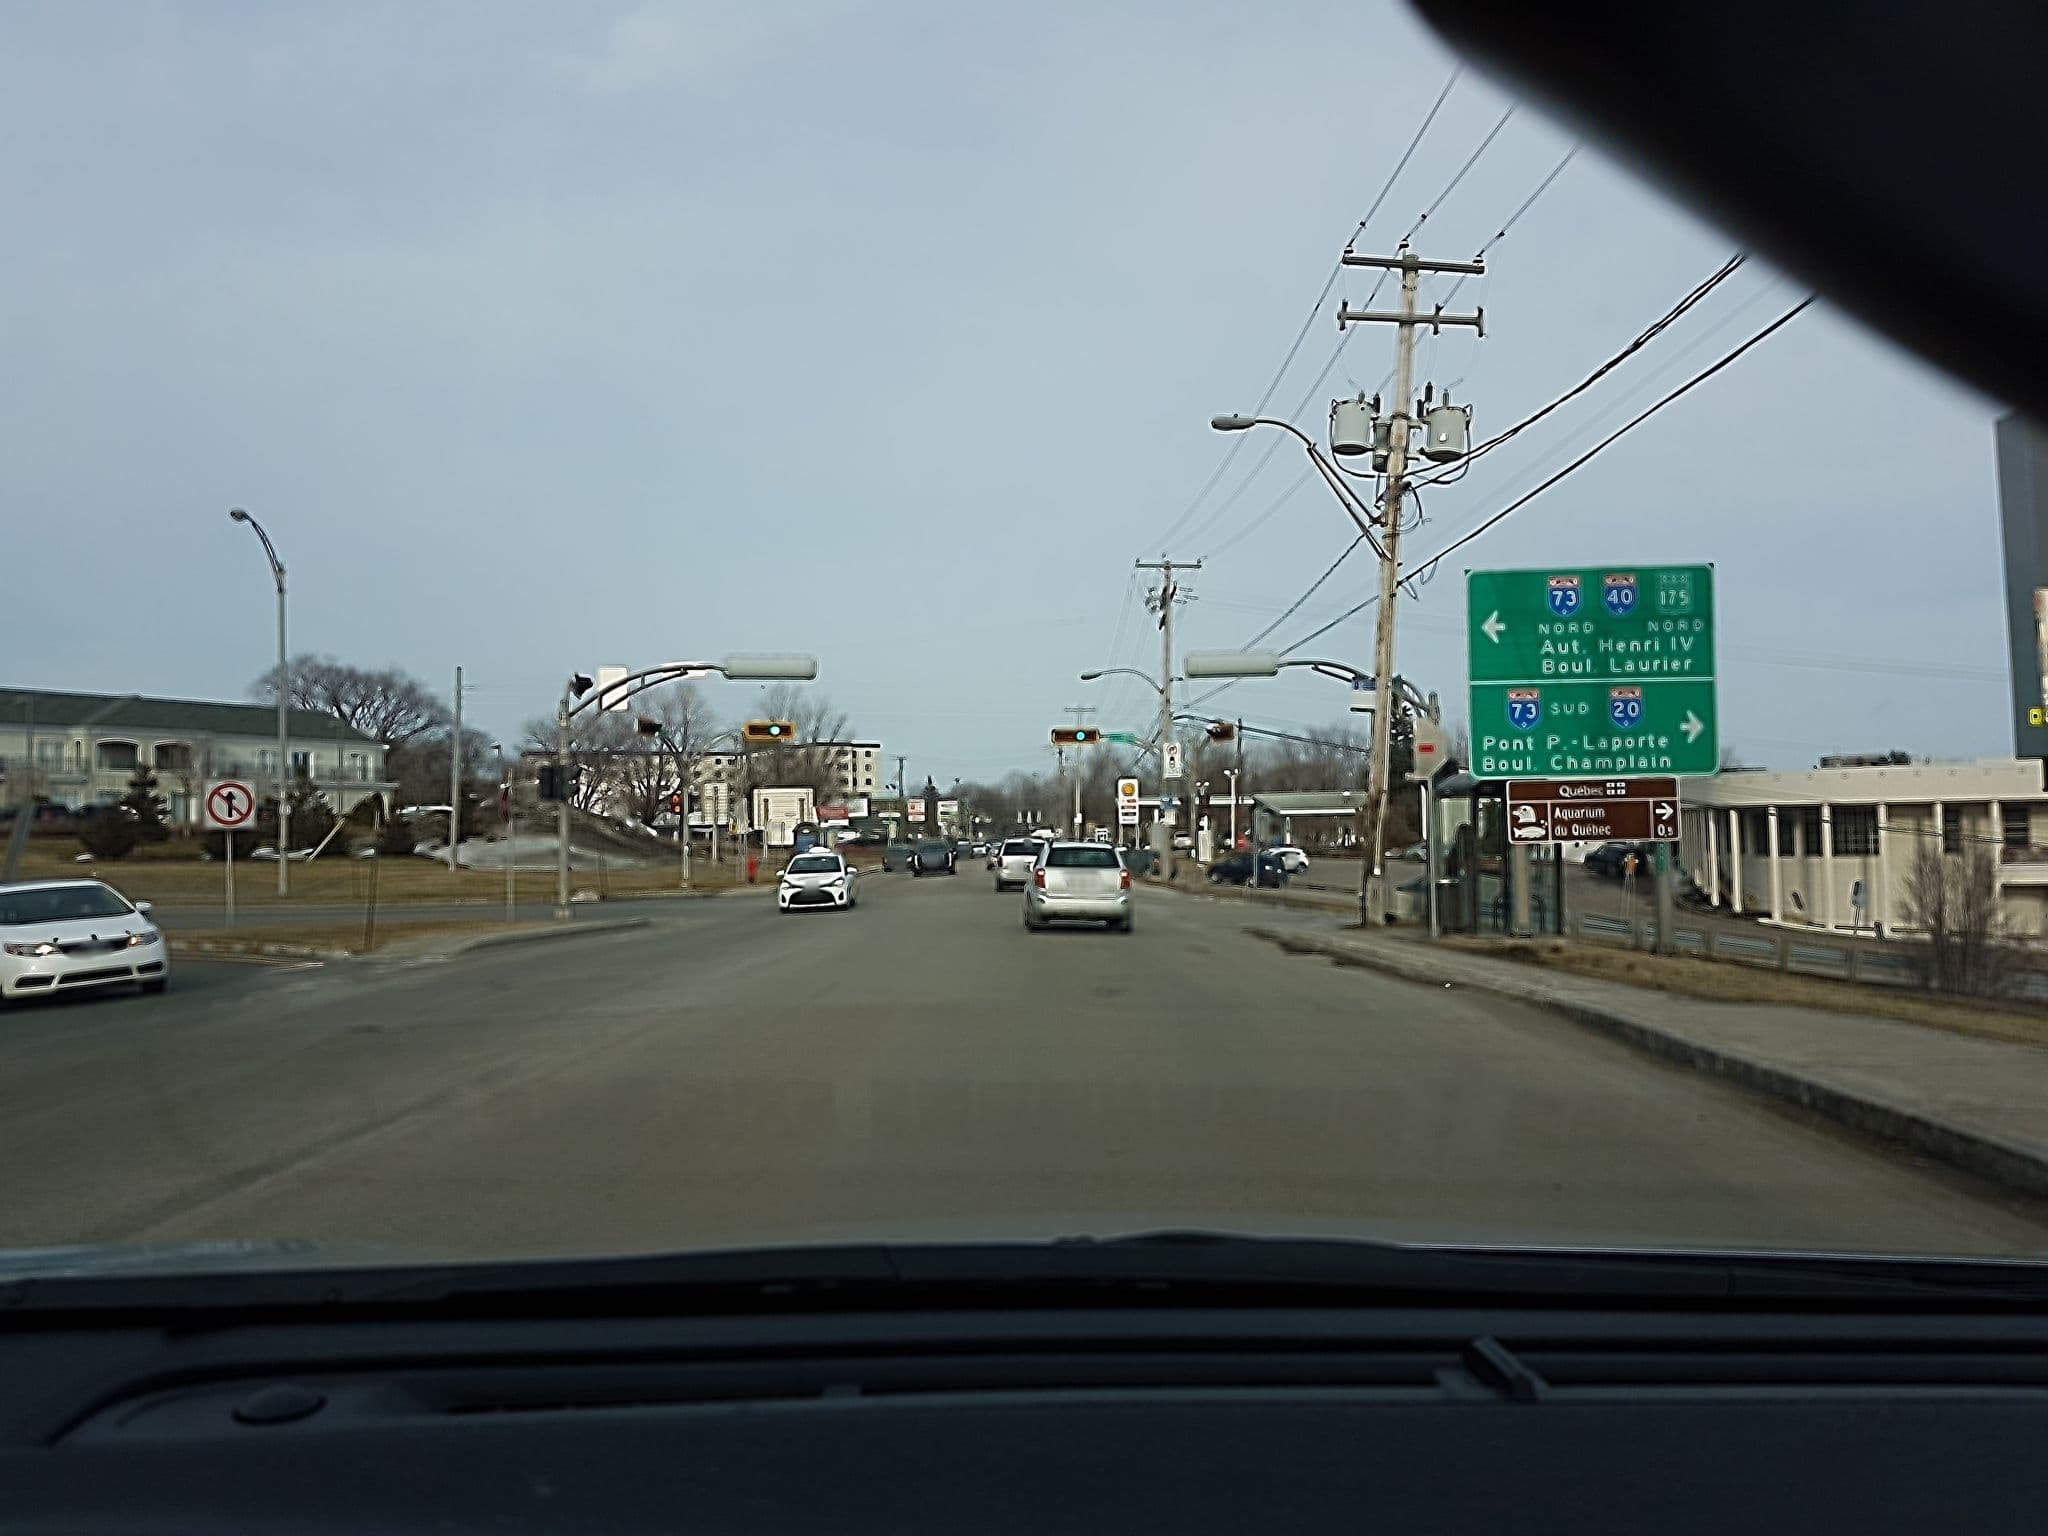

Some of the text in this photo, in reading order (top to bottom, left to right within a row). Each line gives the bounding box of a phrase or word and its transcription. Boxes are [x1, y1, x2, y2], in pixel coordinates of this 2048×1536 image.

[1551, 590, 1577, 606] 73
[1607, 589, 1632, 605] 40
[1660, 589, 1689, 605] 175
[1538, 622, 1593, 634] NORD
[1647, 619, 1703, 631] NORD
[1599, 637, 1659, 652] Henri
[1671, 637, 1693, 651] IV
[1610, 657, 1692, 672] Laurier
[1512, 703, 1537, 719] 73
[1550, 704, 1589, 714] SUD
[1613, 702, 1638, 717] 20
[1483, 736, 1534, 751] Pont
[1551, 755, 1671, 771] Champlain
[1559, 784, 1604, 798] Québec
[1555, 807, 1605, 819] Aquarium
[1555, 824, 1611, 836] du Québec
